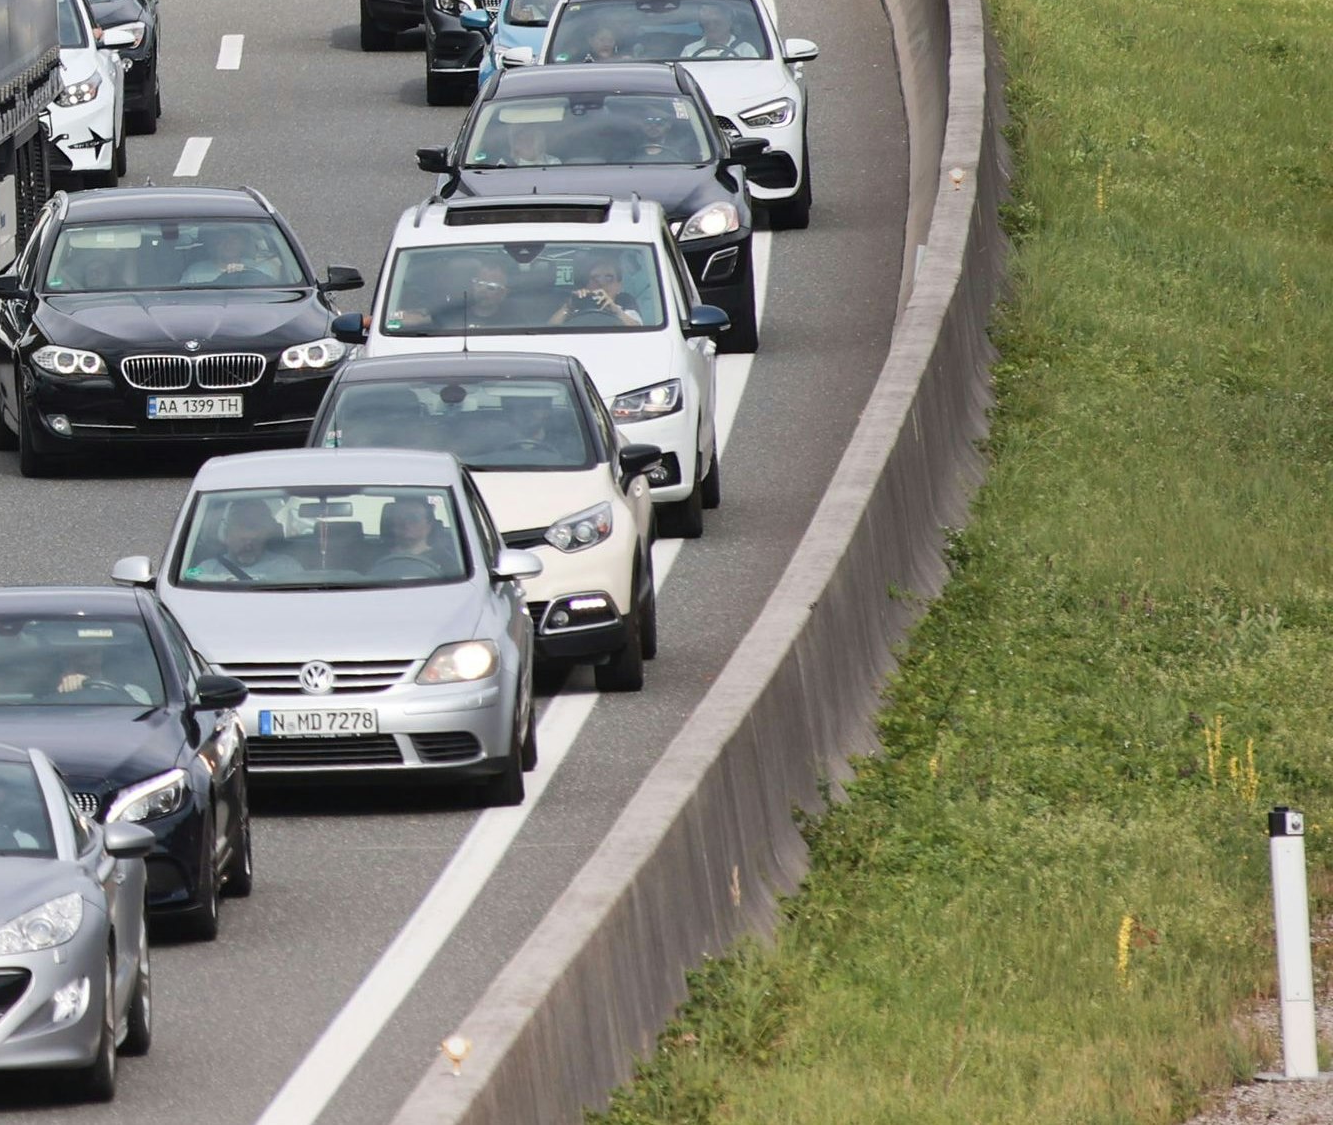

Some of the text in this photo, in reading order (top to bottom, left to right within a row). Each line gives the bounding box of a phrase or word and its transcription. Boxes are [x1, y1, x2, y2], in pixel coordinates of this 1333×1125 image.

[158, 398, 239, 414] AA 1399 TH
[273, 711, 374, 732] N MD 7278
